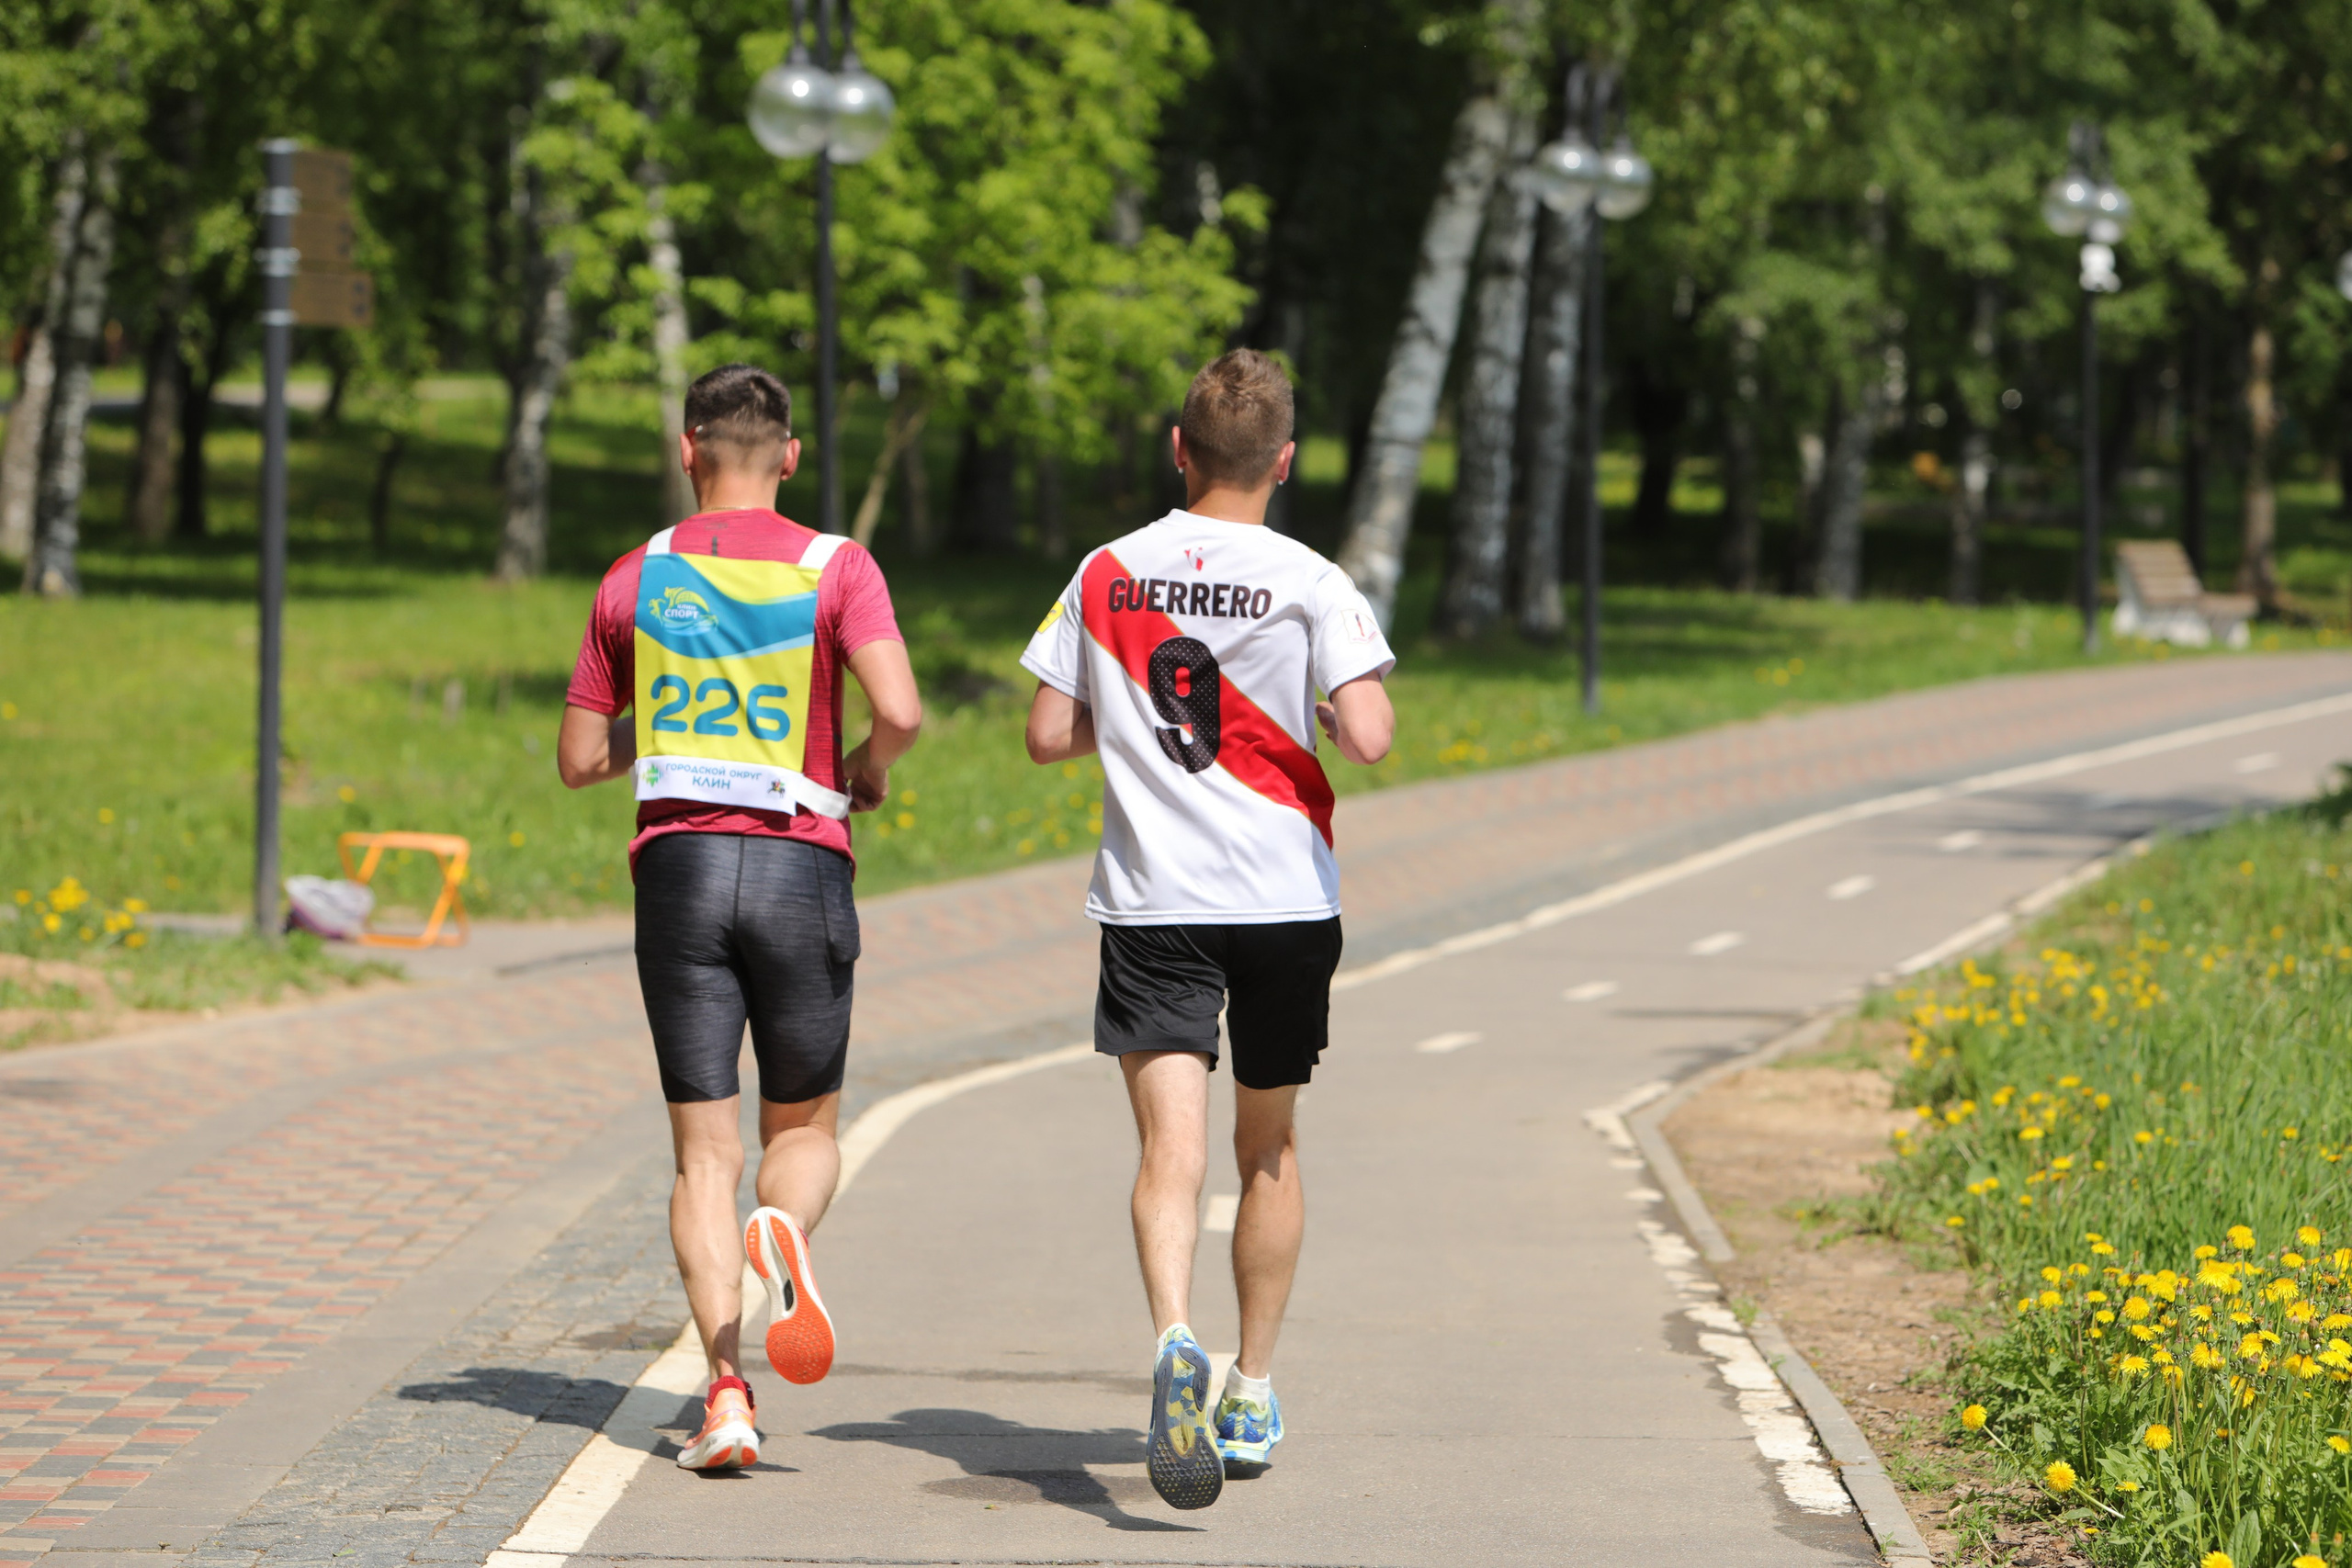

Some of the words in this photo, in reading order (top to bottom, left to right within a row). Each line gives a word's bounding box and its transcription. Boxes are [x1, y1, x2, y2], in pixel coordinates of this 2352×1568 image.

[1107, 576, 1272, 620] GUERRERO
[664, 608, 699, 620] СПОРТ
[650, 673, 791, 742] 226
[1147, 635, 1221, 774] 9
[665, 762, 726, 776] ГОРОДСКОЙ
[729, 770, 763, 781] ОКРУГ
[691, 775, 731, 790] КЛИН
